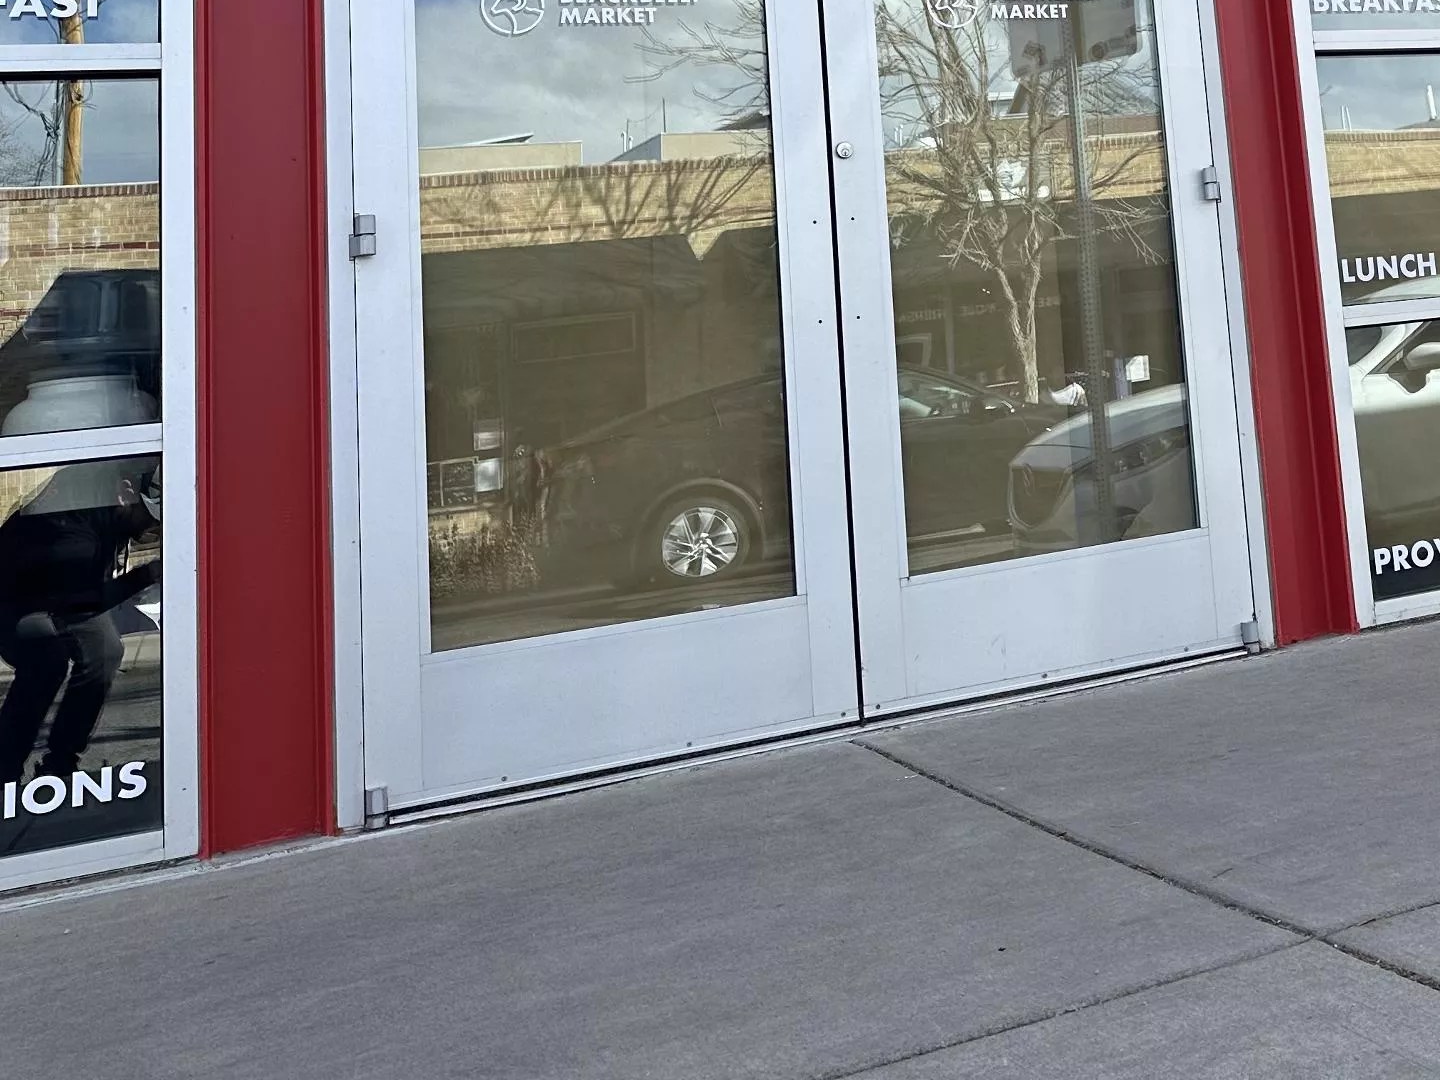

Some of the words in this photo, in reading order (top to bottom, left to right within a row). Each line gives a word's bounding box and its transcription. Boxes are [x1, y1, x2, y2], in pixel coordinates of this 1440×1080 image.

[560, 6, 657, 25] MARKET
[990, 3, 1069, 19] MARKET
[1341, 252, 1437, 283] LUNCH
